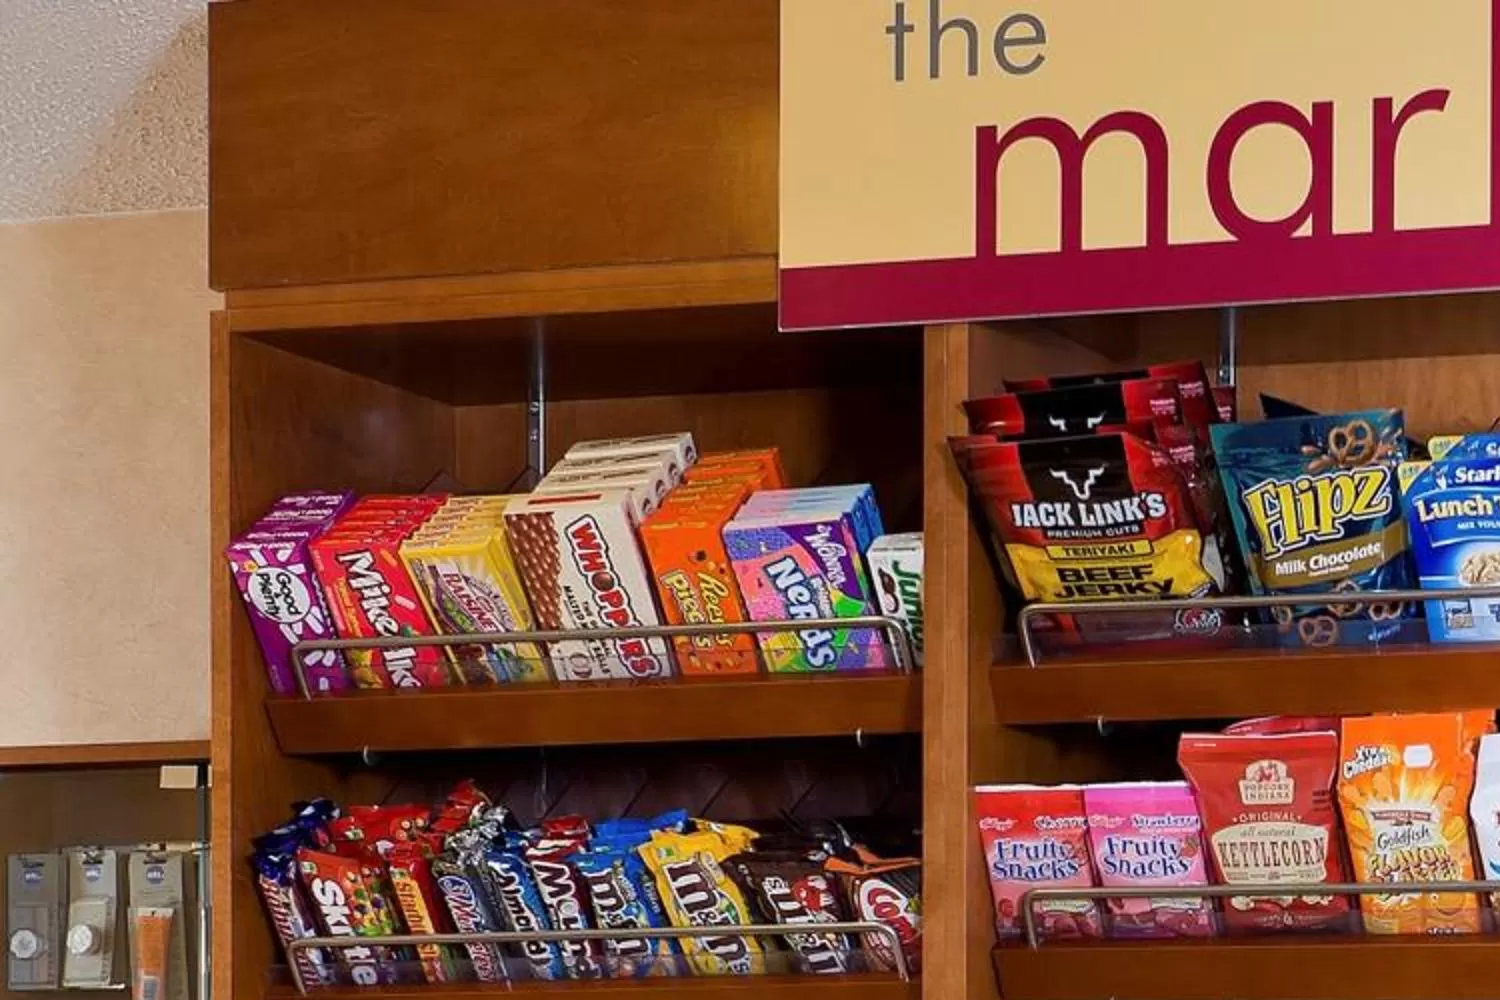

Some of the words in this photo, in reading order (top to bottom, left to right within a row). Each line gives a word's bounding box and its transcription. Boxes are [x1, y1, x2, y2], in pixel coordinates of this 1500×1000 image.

[885, 0, 1047, 82] the
[1011, 501, 1076, 528] JACK
[1079, 492, 1168, 527] LINK'S
[1243, 467, 1392, 560] Flipz
[1416, 494, 1493, 522] Lunch
[1062, 543, 1138, 557] TERIYAKI
[1274, 561, 1308, 577] Milk
[1308, 543, 1383, 571] Chocolate
[1055, 564, 1154, 583] BEEF
[275, 572, 302, 616] Good
[568, 520, 657, 675] WHOPPRS
[1053, 578, 1175, 599] JERKY
[1239, 811, 1296, 823] ORIGINAL
[1105, 836, 1182, 858] Fruity
[1377, 824, 1430, 849] Goldfish
[1217, 837, 1325, 868] KETTLECORN
[992, 858, 1080, 881] Snacks
[1103, 856, 1191, 878] Snacks
